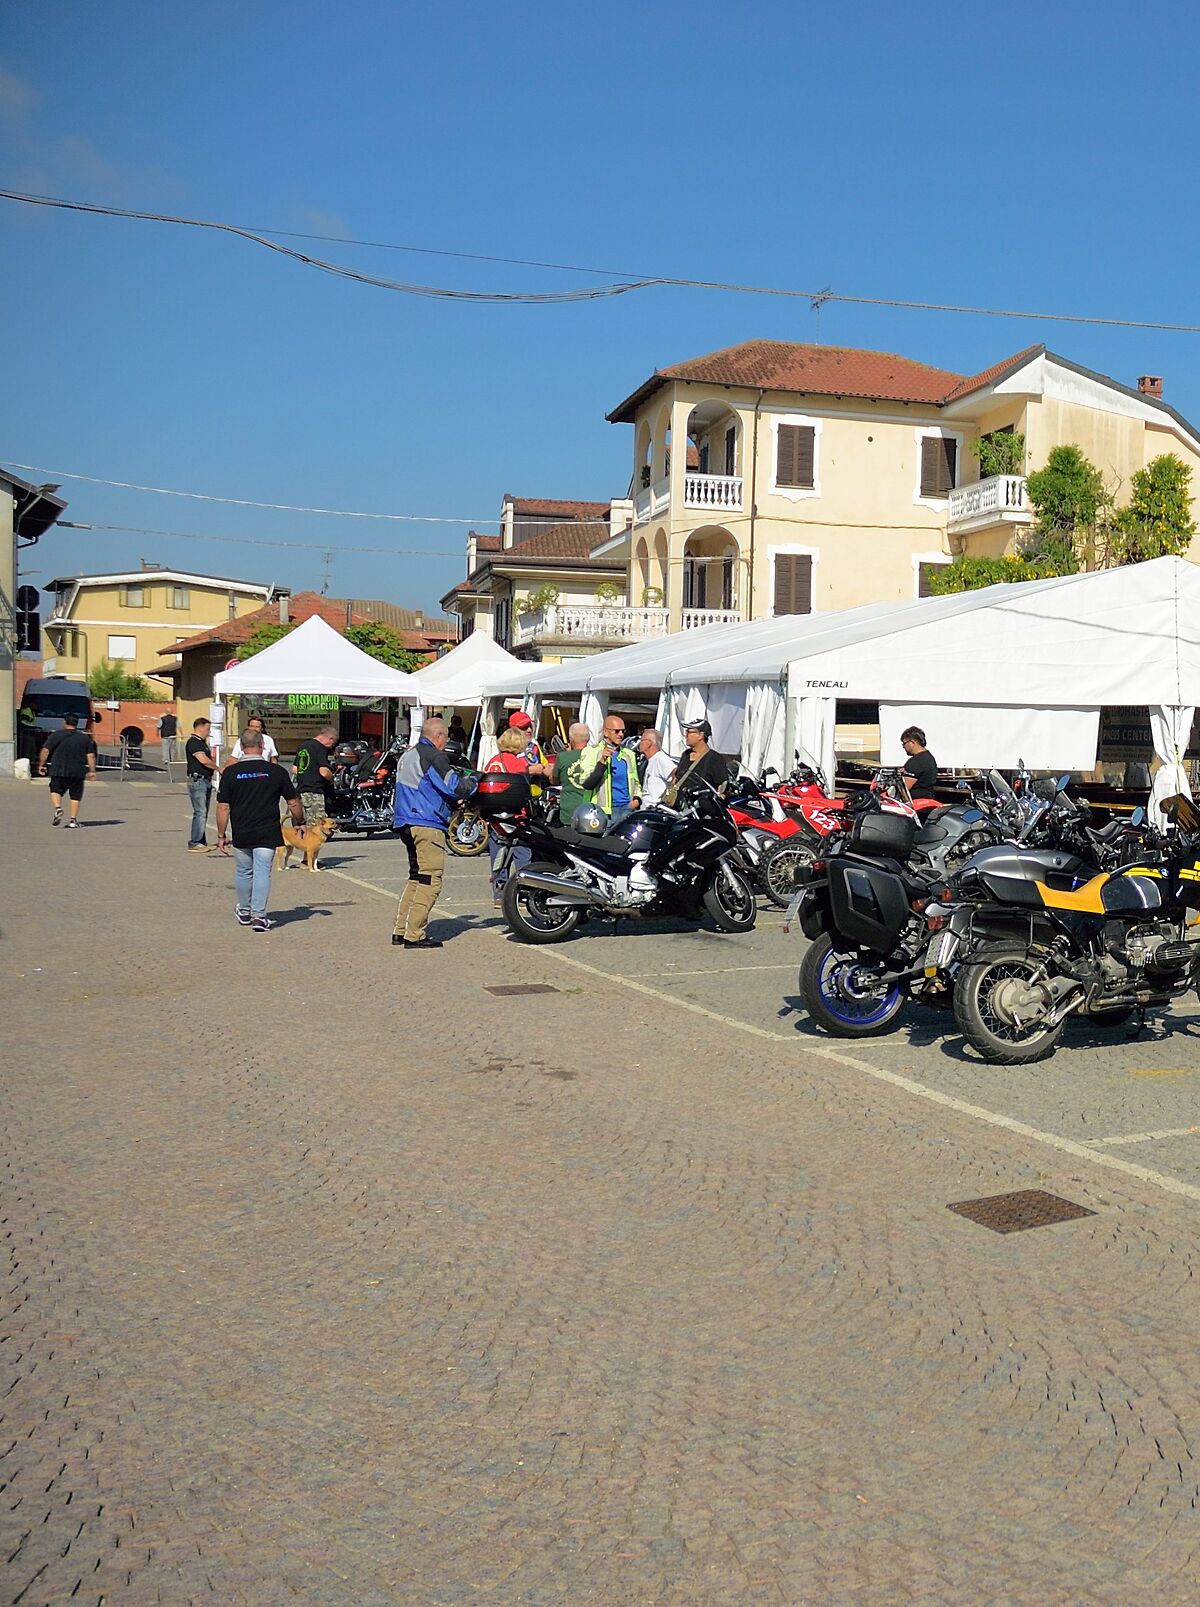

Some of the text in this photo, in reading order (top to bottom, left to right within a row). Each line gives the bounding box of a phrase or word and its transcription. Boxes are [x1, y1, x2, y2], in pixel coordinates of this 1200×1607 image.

[288, 695, 339, 705] BISKO MOTO
[320, 702, 339, 710] CLUB
[809, 809, 836, 830] 123
